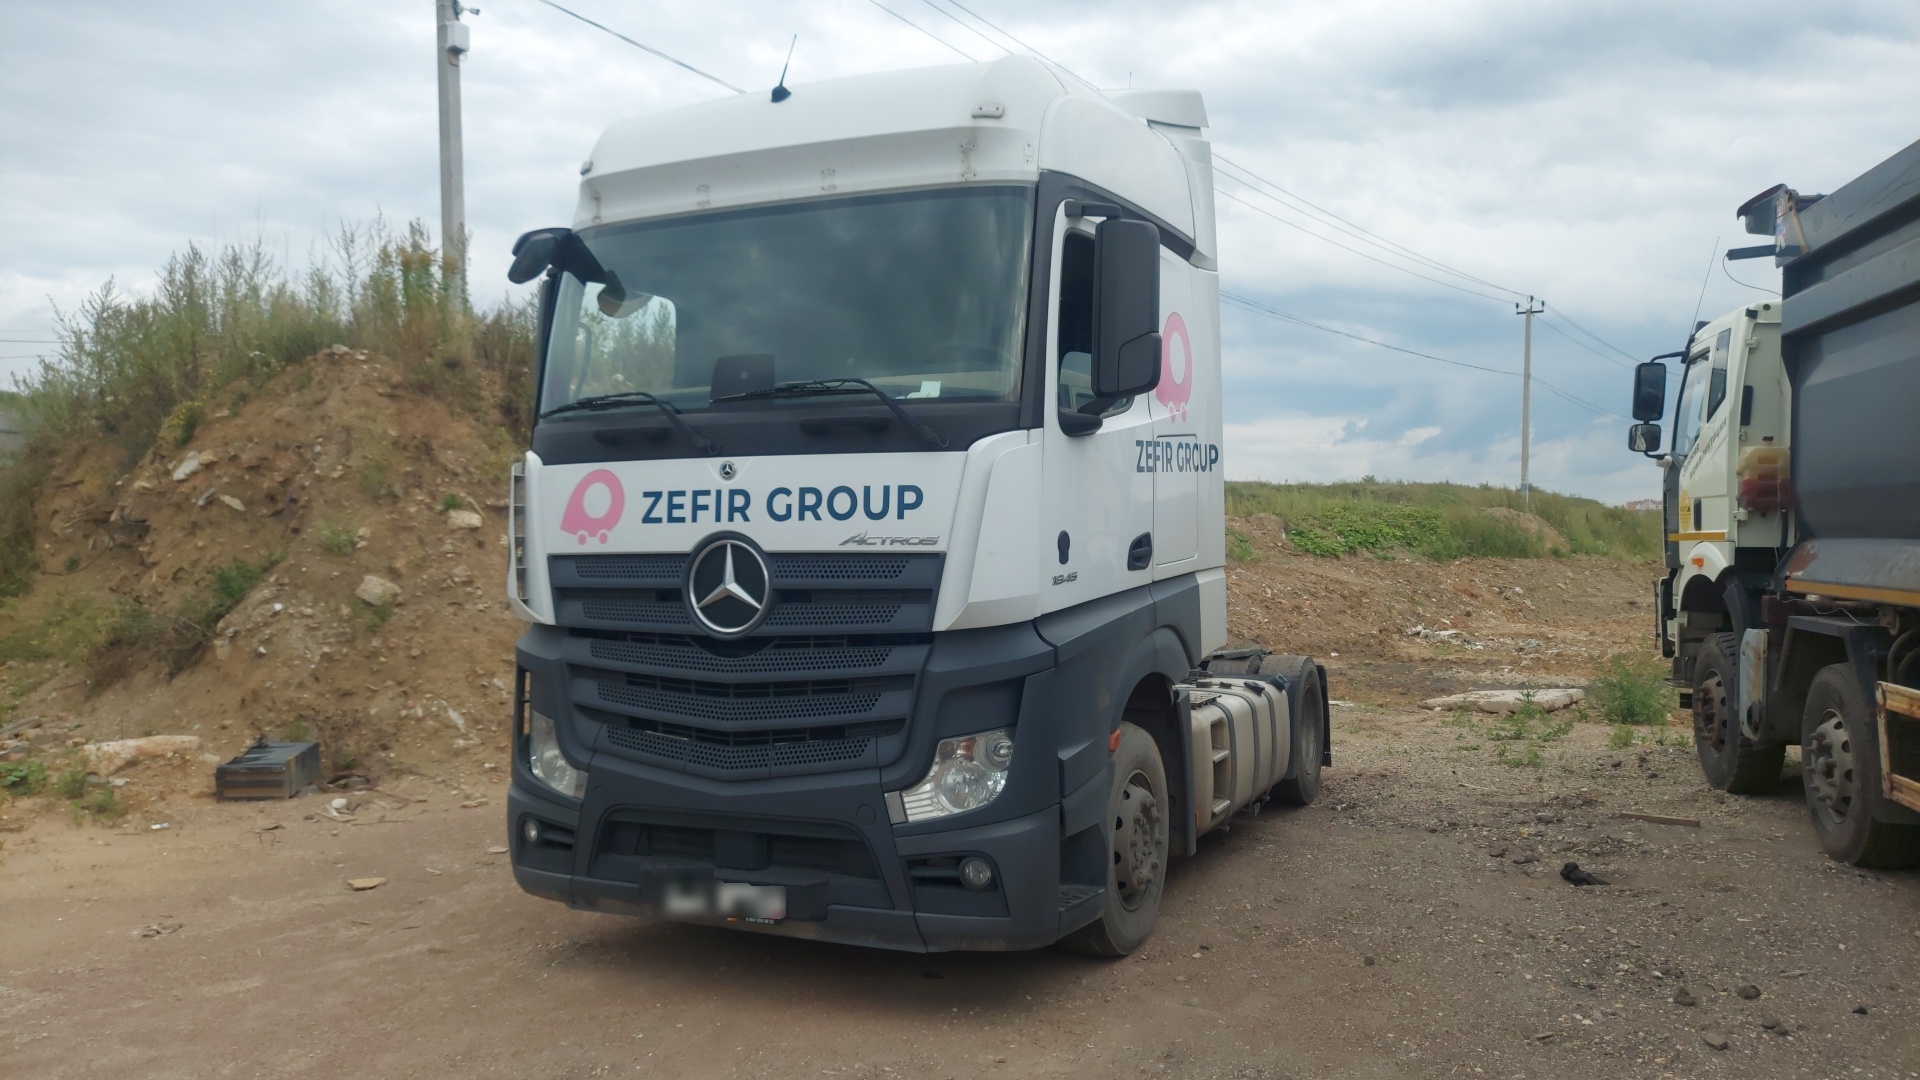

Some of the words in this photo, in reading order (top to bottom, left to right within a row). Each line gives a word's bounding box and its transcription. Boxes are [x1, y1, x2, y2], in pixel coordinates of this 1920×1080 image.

[1136, 440, 1173, 473] ZEFIR
[1177, 442, 1219, 473] GROUP
[641, 488, 751, 524] ZEFIR
[766, 484, 924, 522] GROUP
